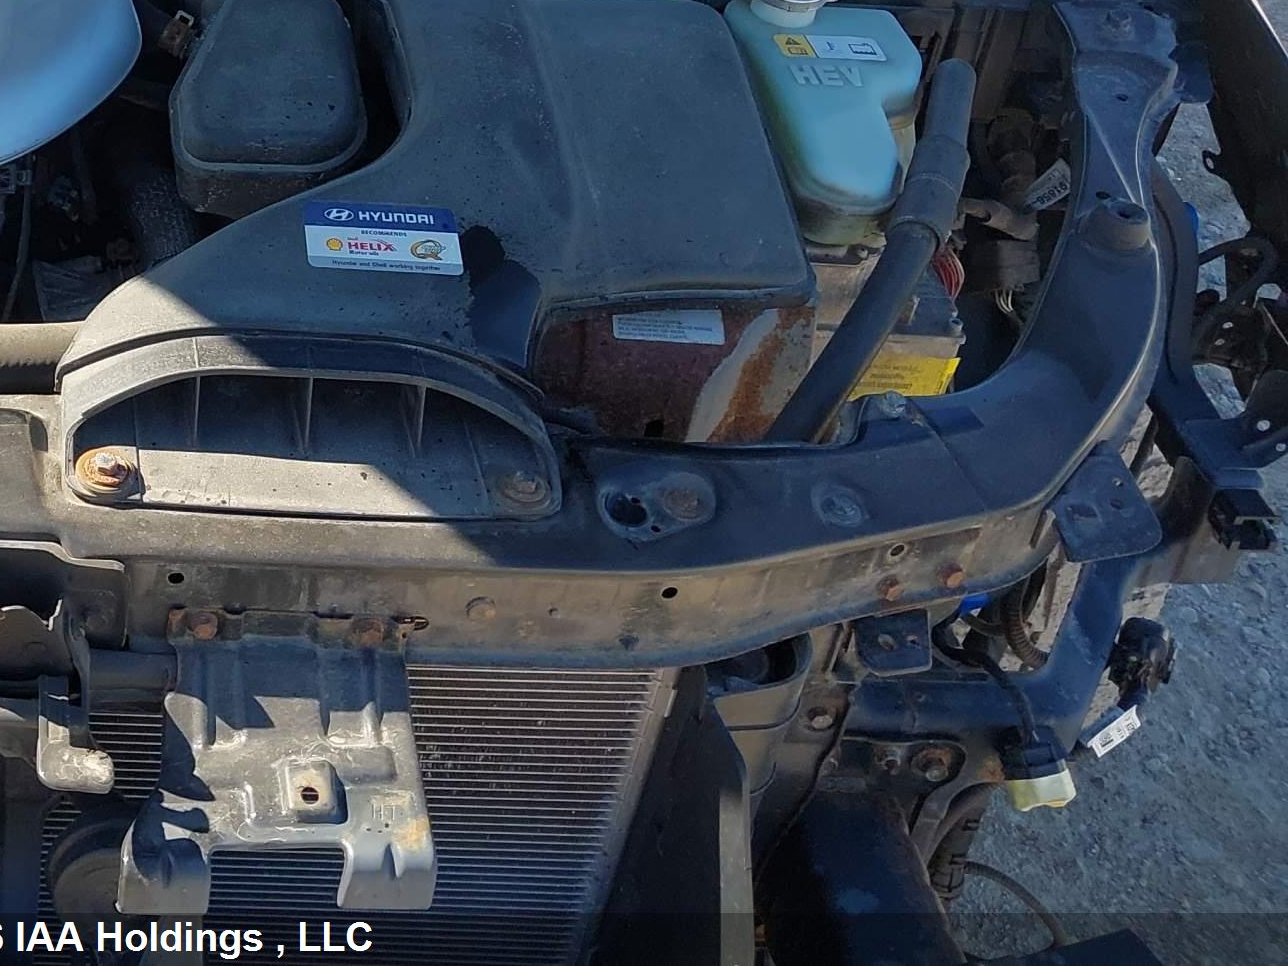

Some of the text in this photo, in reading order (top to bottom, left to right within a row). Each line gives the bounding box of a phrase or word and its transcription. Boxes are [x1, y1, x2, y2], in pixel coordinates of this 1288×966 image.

[788, 65, 864, 88] HEV
[358, 210, 434, 225] HYUNDAI
[347, 240, 395, 252] HELIX
